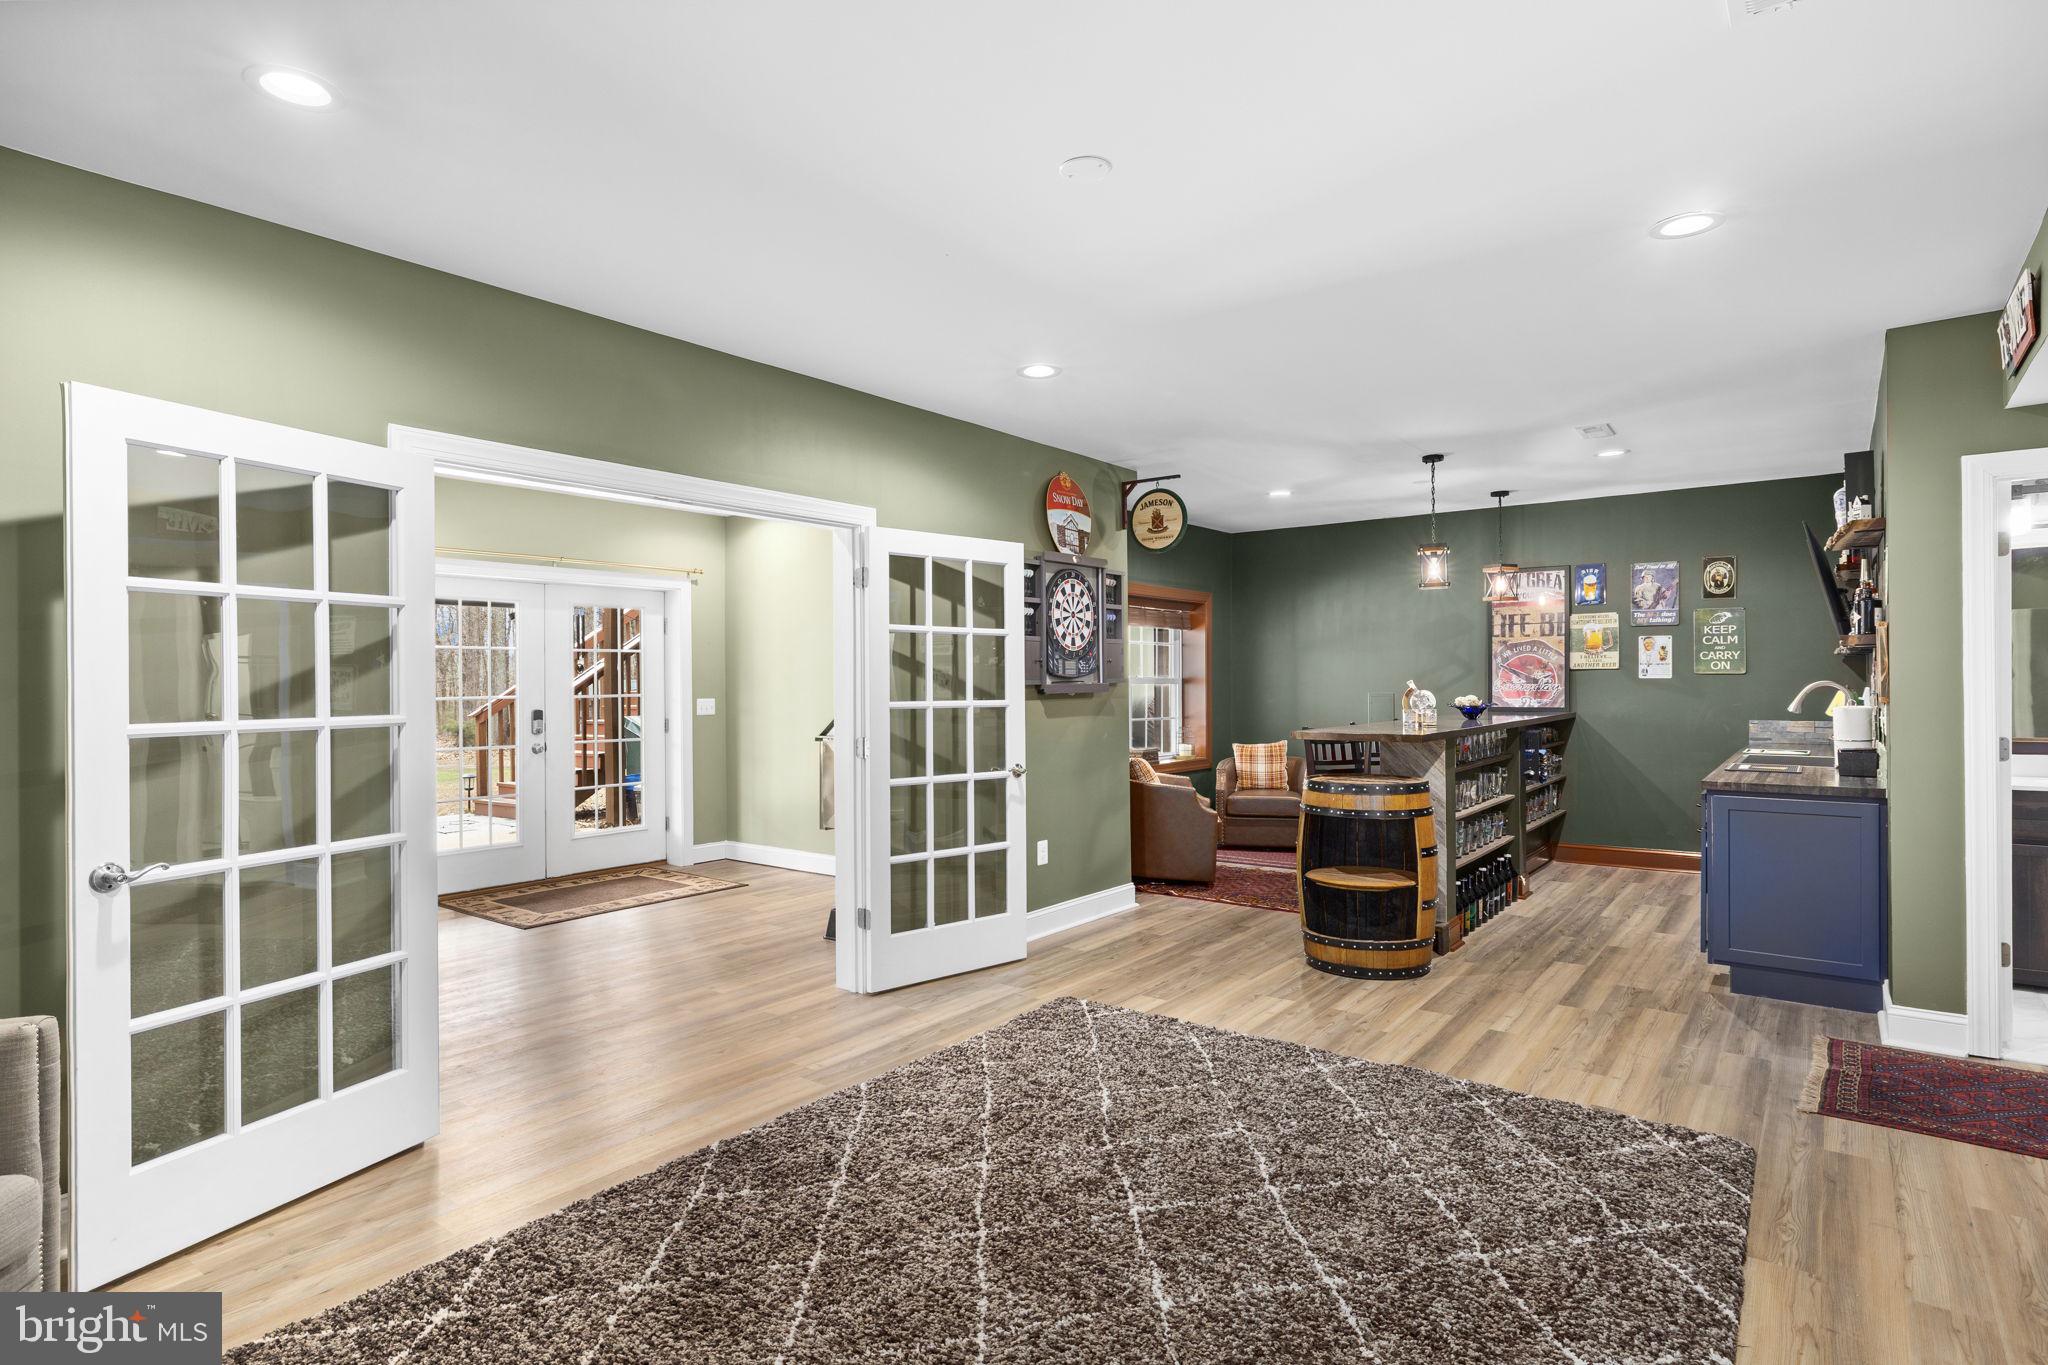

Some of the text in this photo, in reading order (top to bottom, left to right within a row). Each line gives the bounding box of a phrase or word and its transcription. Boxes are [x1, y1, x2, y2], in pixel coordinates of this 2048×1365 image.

[1052, 492, 1071, 504] SNOW
[1071, 496, 1084, 507] DAY
[1139, 498, 1174, 511] JAMESON
[1704, 625, 1737, 634] KEEP
[1702, 635, 1738, 645] CALM
[1513, 645, 1532, 653] LIVED
[1700, 651, 1740, 660] CARRY
[1710, 661, 1730, 670] ON
